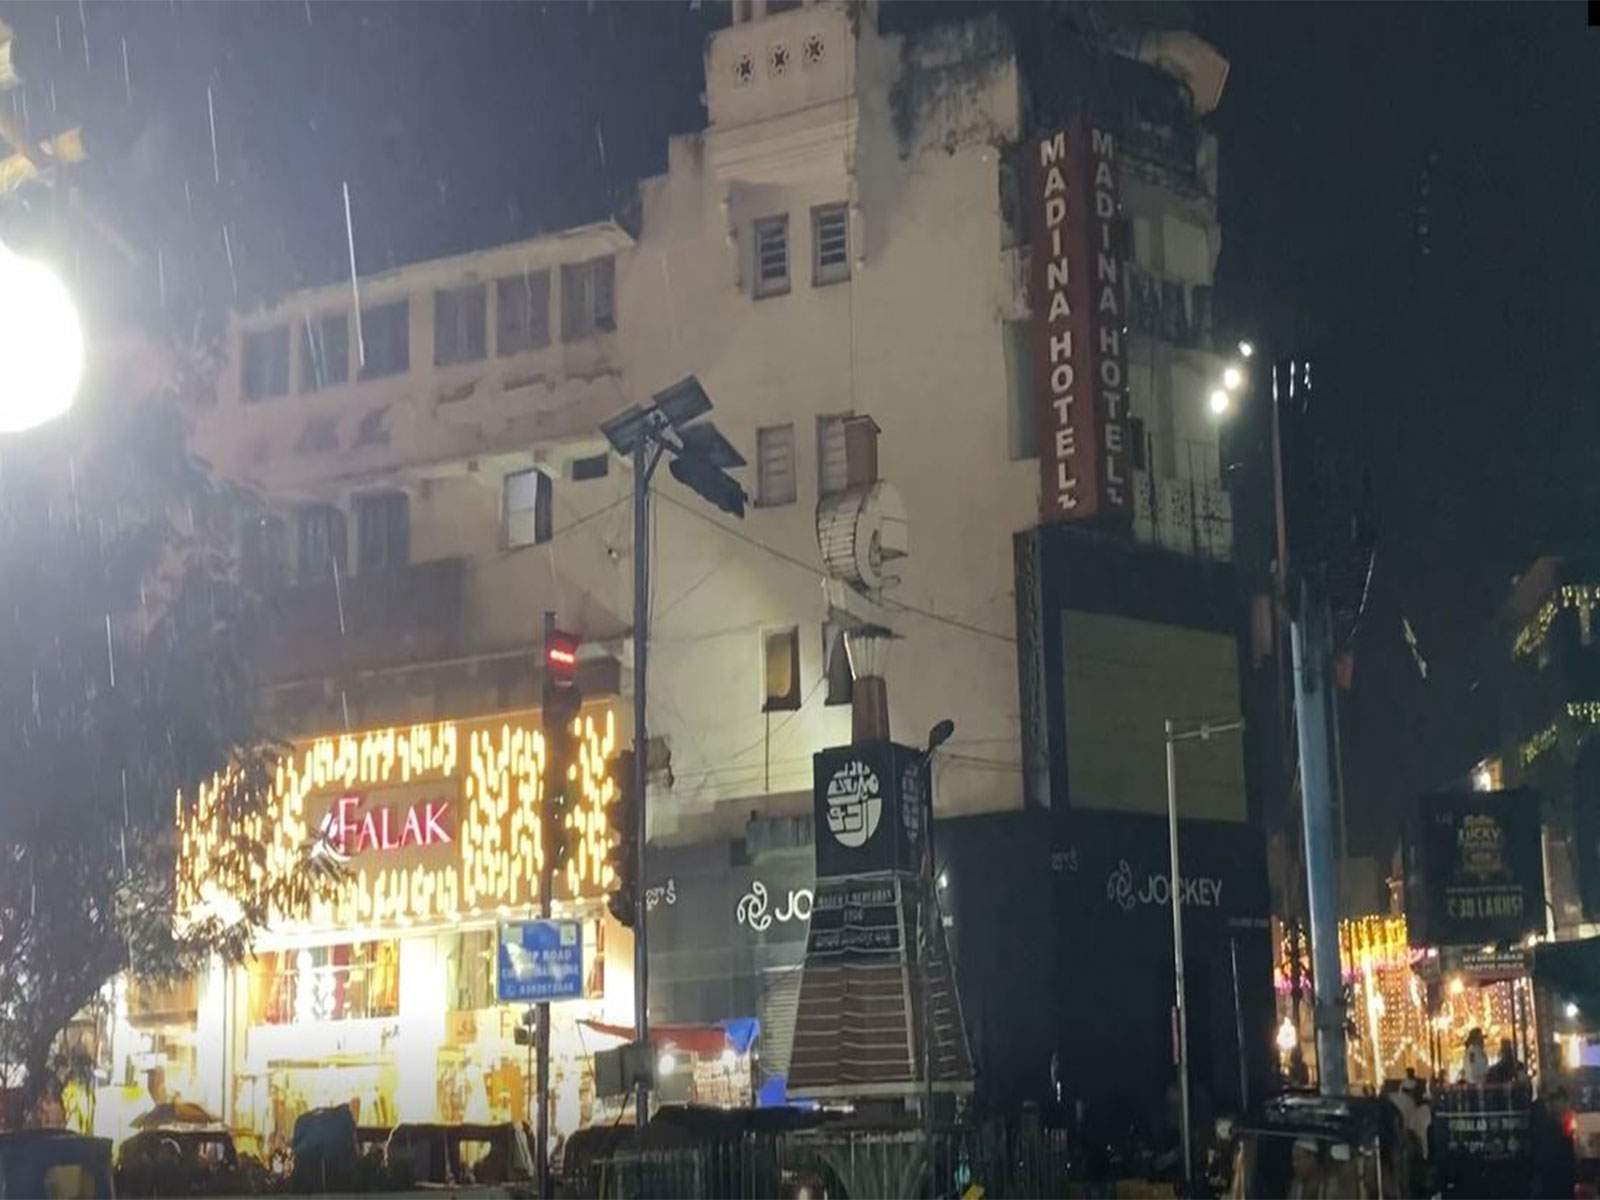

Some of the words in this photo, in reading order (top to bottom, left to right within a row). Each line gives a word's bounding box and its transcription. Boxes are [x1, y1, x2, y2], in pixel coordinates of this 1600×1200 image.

[1041, 131, 1071, 323] MADINA
[1092, 128, 1119, 315] MADINA
[1050, 331, 1077, 490] HOTEL
[1100, 326, 1125, 483] HOTEL
[338, 797, 452, 854] FALAK
